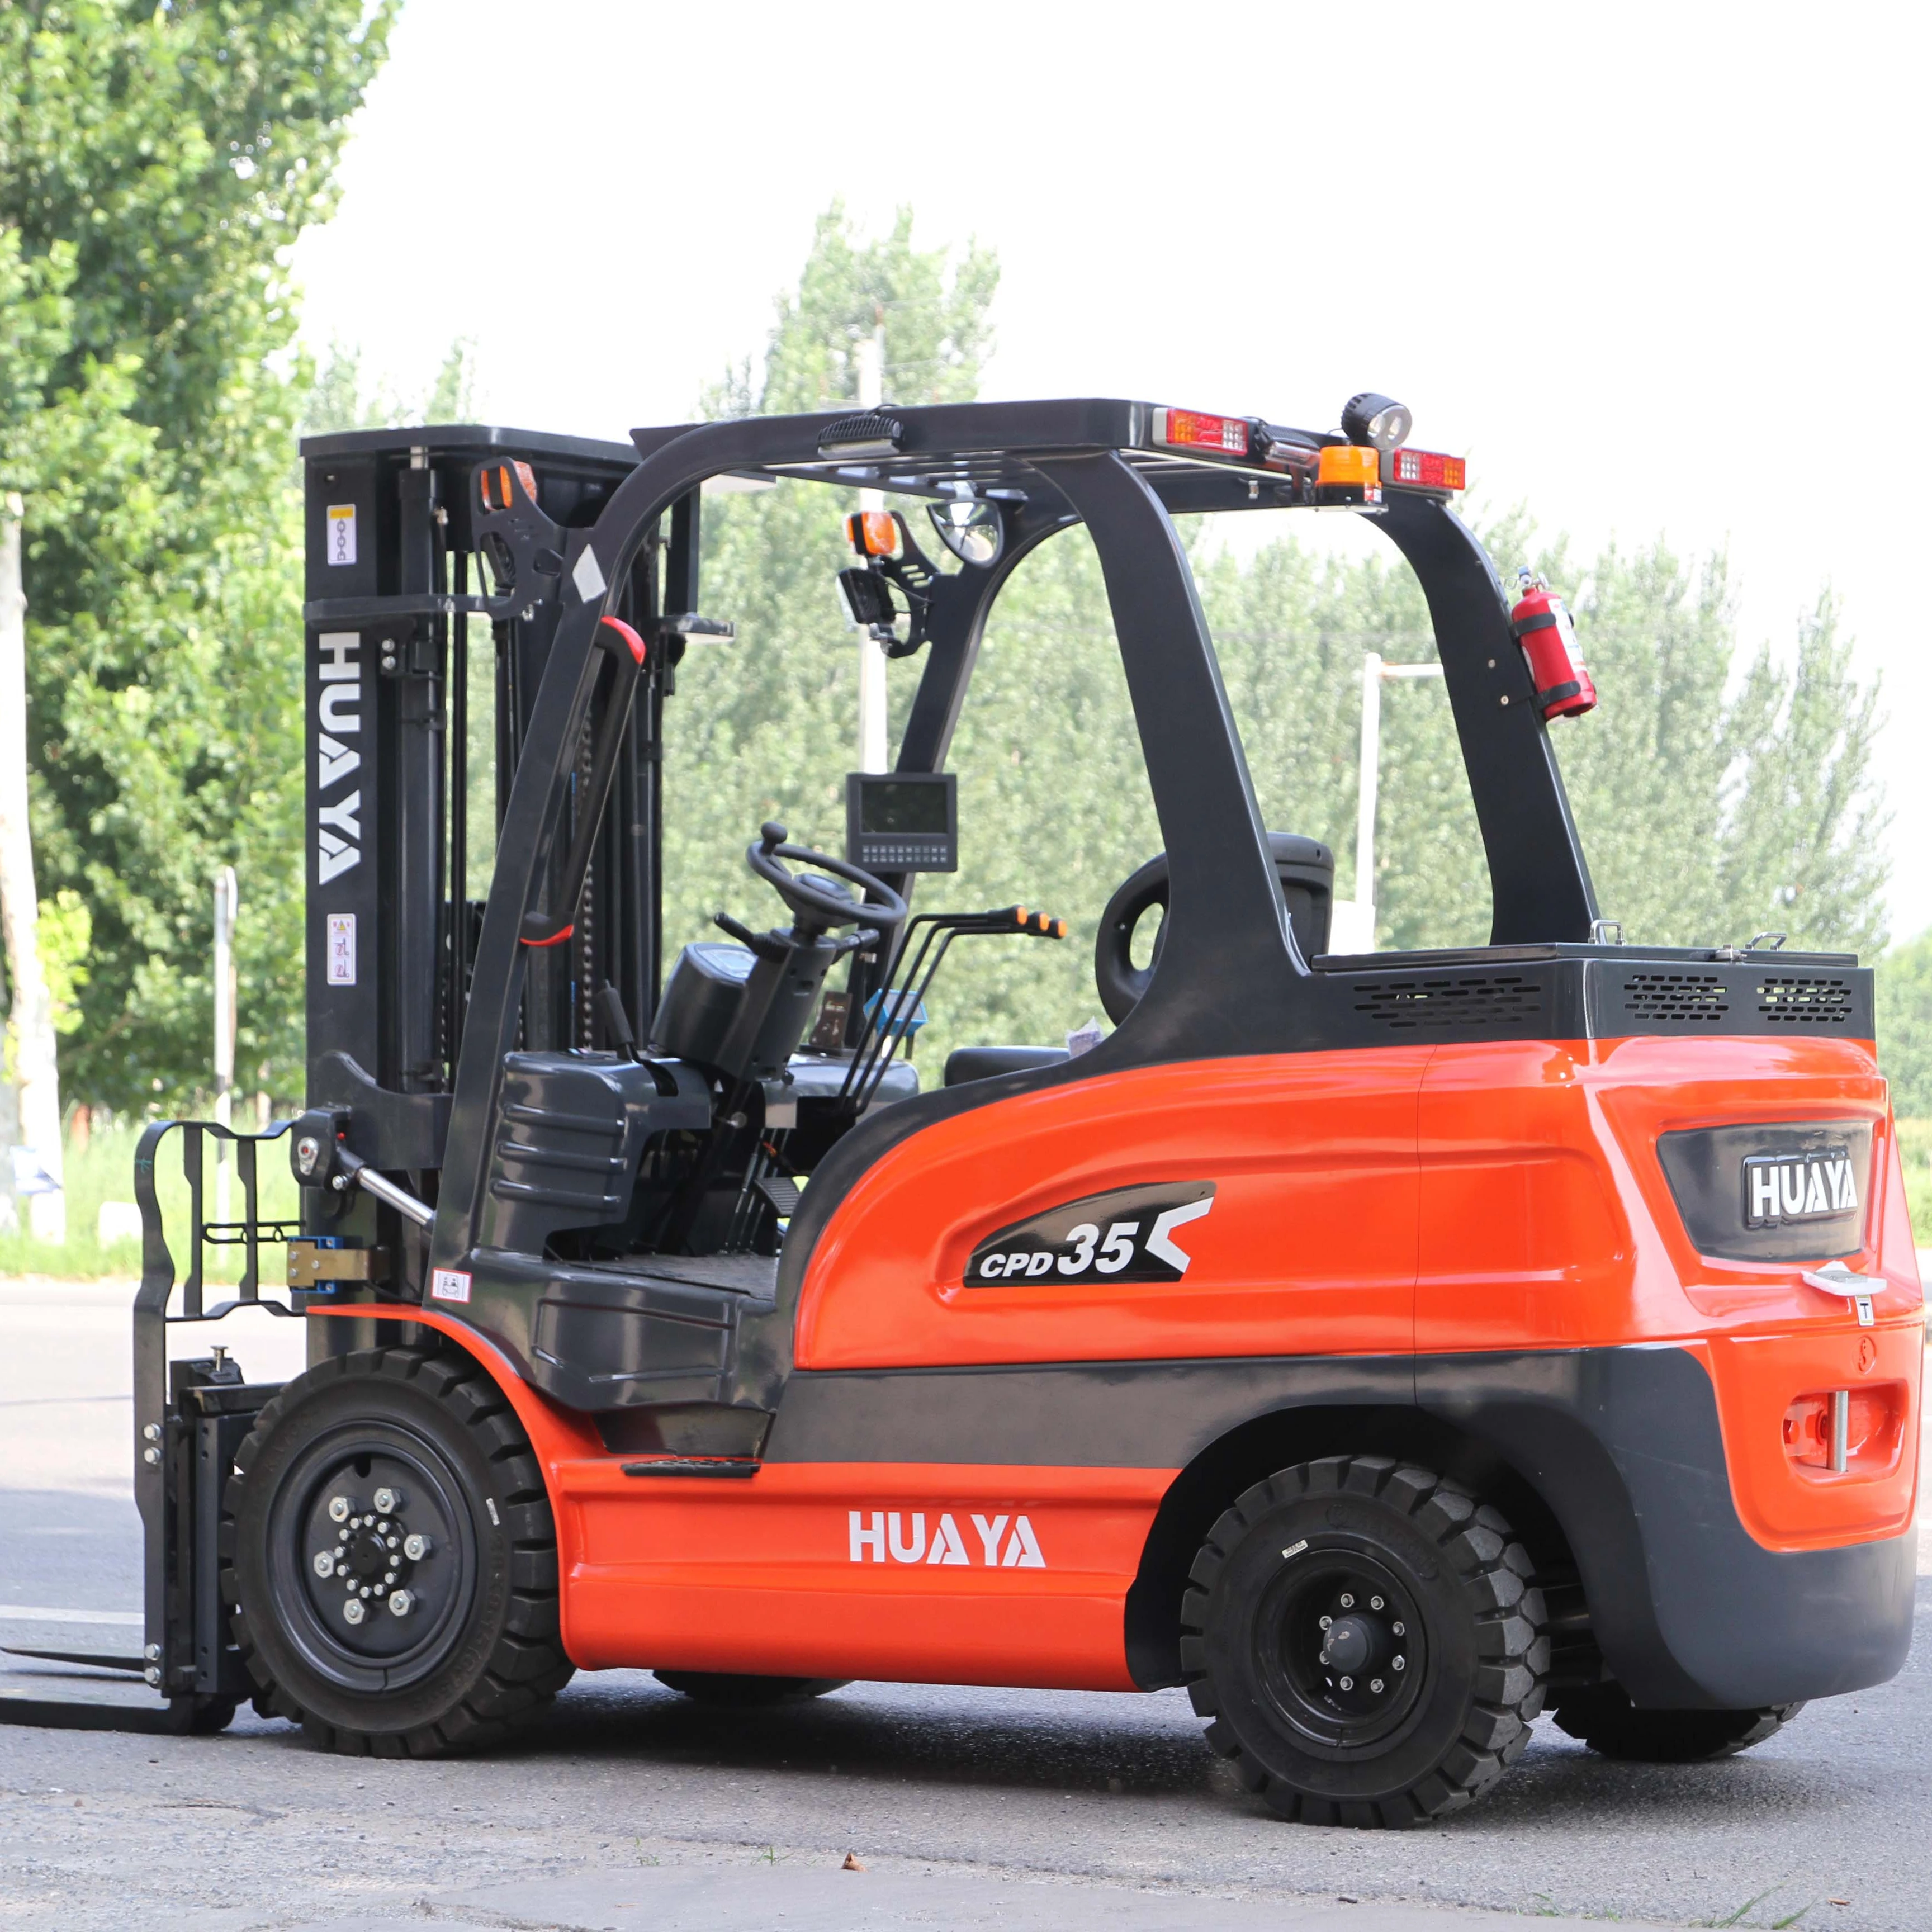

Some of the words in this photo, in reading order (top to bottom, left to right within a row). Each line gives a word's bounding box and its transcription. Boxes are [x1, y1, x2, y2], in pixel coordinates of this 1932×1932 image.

[319, 633, 361, 885] HUAYA
[1751, 1159, 1858, 1218] HUAYA
[849, 1511, 1046, 1568] HUAYA
